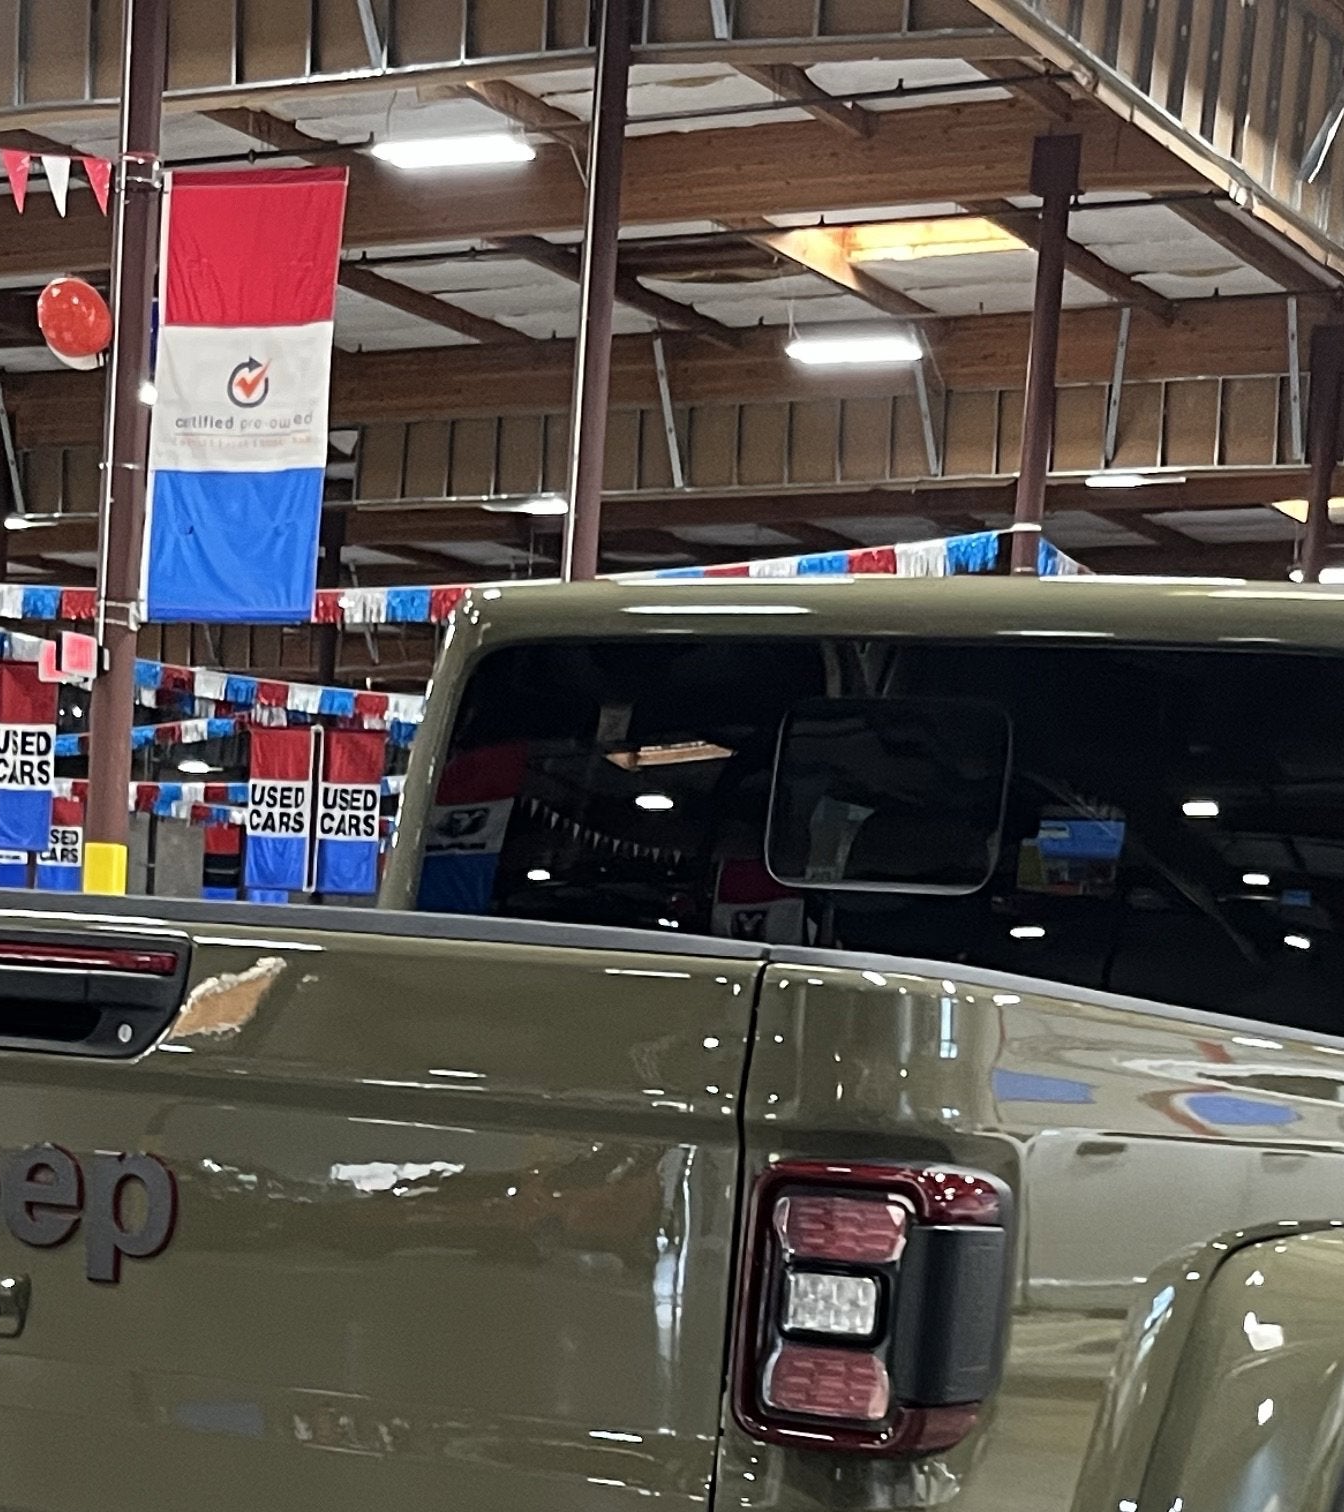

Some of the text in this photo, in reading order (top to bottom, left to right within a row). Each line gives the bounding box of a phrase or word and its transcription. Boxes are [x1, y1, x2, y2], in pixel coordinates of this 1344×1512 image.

[252, 784, 305, 808] USED
[322, 787, 377, 812] USED
[249, 809, 305, 833] CARS
[320, 812, 376, 836] CARS
[50, 828, 79, 846] SED
